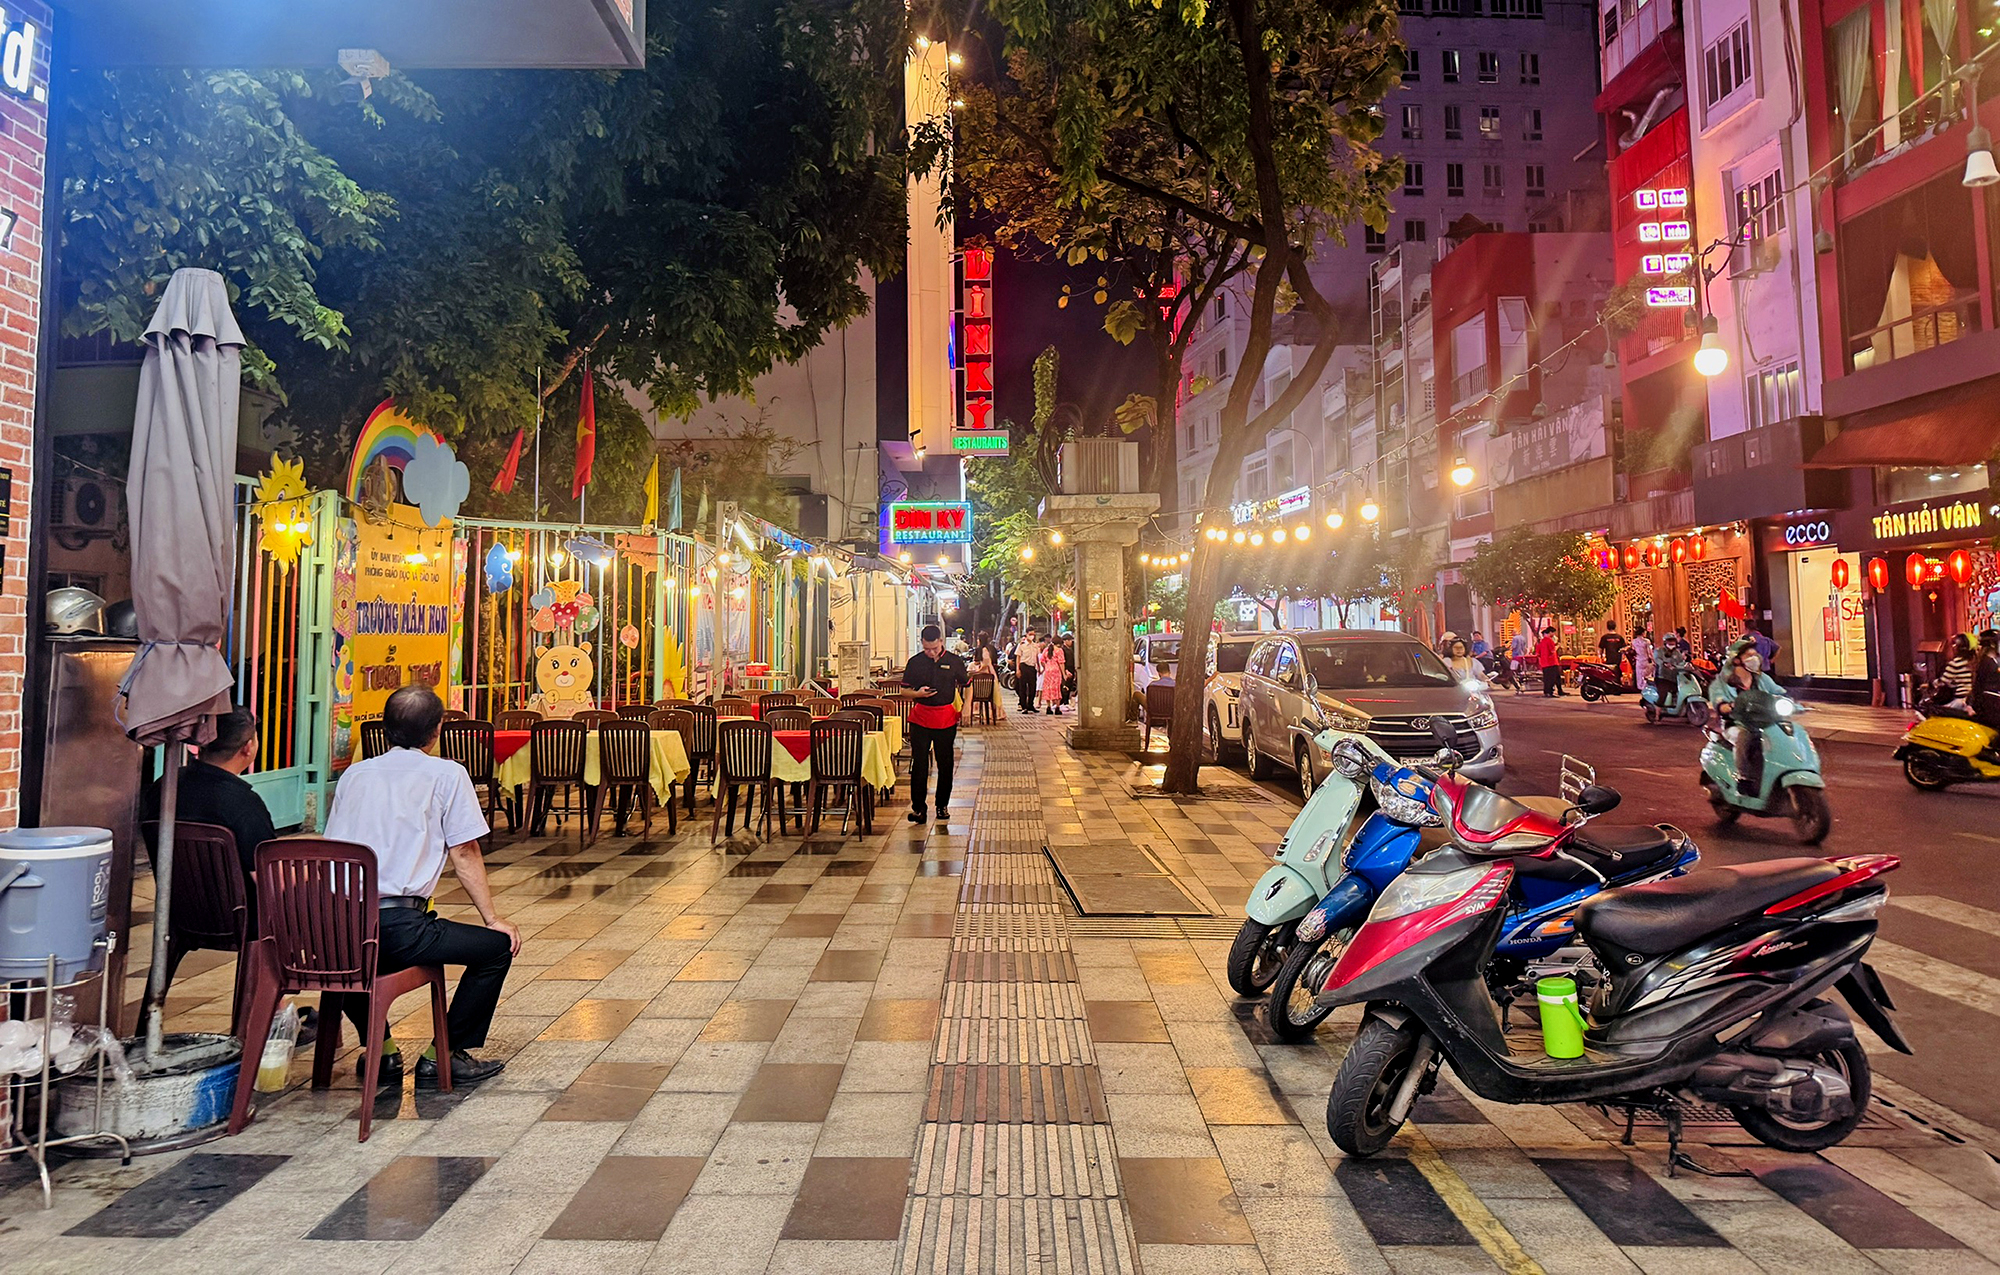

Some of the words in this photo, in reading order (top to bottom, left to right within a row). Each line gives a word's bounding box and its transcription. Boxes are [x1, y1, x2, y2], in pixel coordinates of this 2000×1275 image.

[952, 436, 1008, 450] RESTAURANTS
[937, 504, 966, 530] KÝ
[1872, 510, 1906, 539] TÂN
[1908, 502, 1938, 535] HẢI
[1940, 501, 1981, 529] VÂN
[895, 530, 966, 540] RESTAURANT
[1785, 521, 1830, 544] ecco
[356, 594, 398, 634] TRƯỜNG
[401, 590, 426, 634] MẦM
[428, 605, 448, 634] NON
[1465, 901, 1486, 915] SYM
[1509, 936, 1543, 945] HONDA
